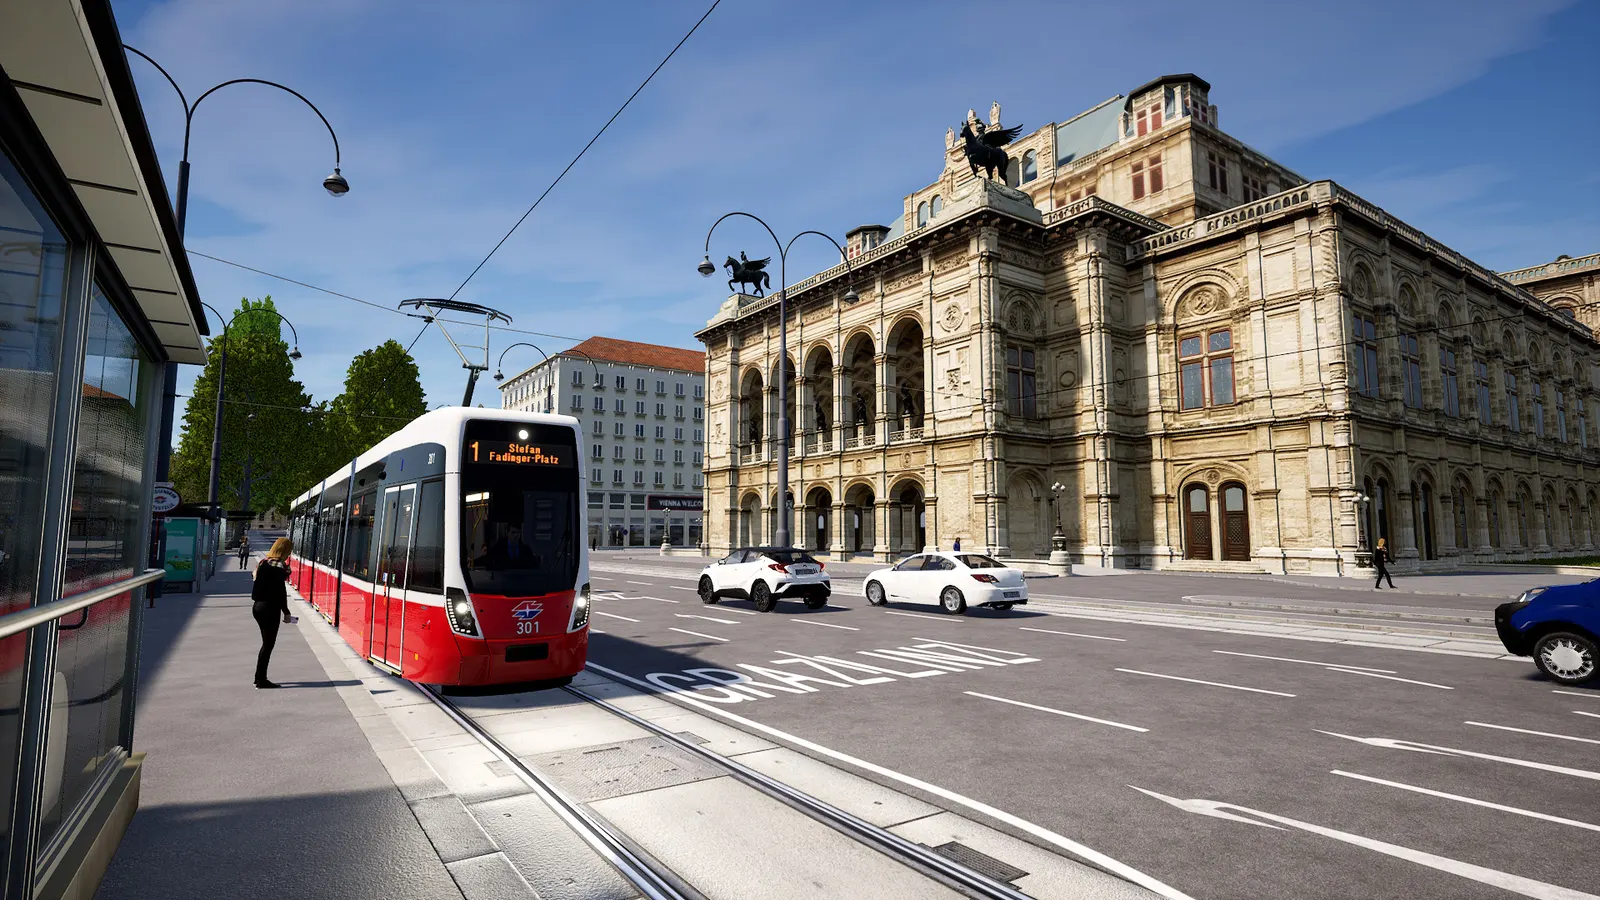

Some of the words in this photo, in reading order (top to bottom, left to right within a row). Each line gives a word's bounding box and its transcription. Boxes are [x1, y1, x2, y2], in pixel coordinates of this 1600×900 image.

[471, 441, 479, 462] 1
[509, 443, 541, 454] Stefan
[489, 451, 559, 465] Fadinger-Platz
[516, 621, 539, 634] 301
[645, 650, 897, 704] GRAZ
[813, 637, 1042, 678] LINZ
